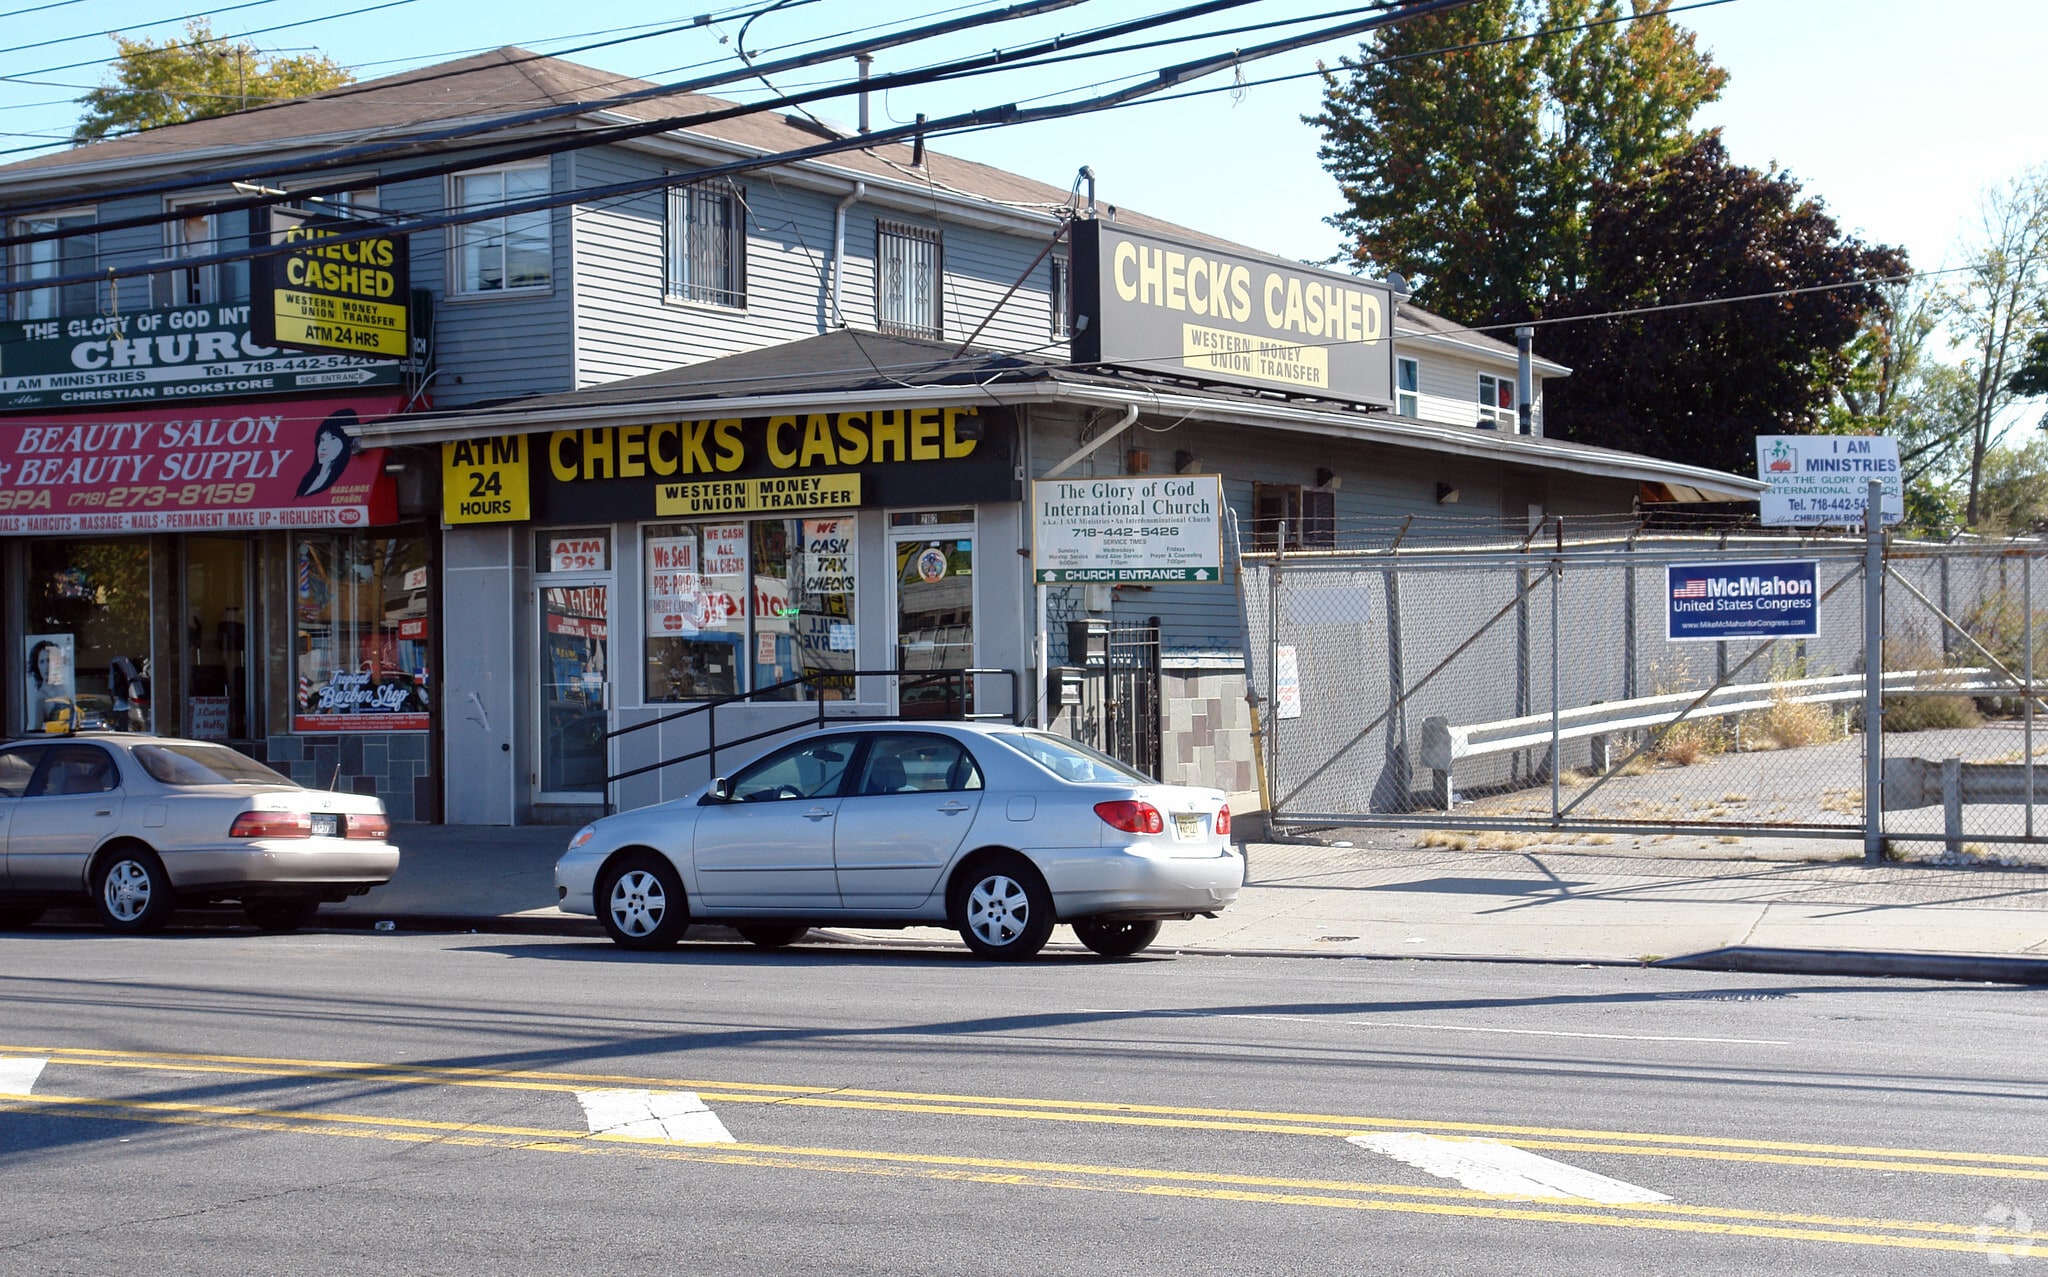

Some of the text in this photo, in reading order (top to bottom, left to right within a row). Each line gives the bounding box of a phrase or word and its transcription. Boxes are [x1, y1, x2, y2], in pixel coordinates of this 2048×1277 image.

[287, 225, 394, 267] CHECKS
[287, 257, 395, 298] CASHED
[1114, 241, 1381, 346] CHECKS CASHED
[285, 293, 378, 315] WESTERN MONEY
[22, 322, 59, 341] THE
[67, 315, 130, 338] GLORY
[136, 313, 162, 332] OF
[169, 310, 210, 330] GOD
[301, 306, 395, 326] UNION TRANSFER
[305, 325, 380, 347] ATM 24 HRS
[1190, 328, 1301, 360] WESTERN MONEY
[71, 330, 304, 370] CHURC
[202, 356, 377, 377] Tel. 718-442-5426
[1210, 350, 1321, 384] UNION TRANSFER
[2, 370, 146, 391] I AM MINISTRIES
[300, 371, 365, 384] SIDE ENTRANCE
[61, 388, 155, 402] CHRISTIAN
[163, 379, 274, 396] BOOKSTORE
[15, 415, 283, 454] BEAUTY SALON
[549, 407, 979, 482] CHECKS CASHED
[451, 434, 520, 468] ATM
[1833, 440, 1871, 454] I AM
[14, 454, 155, 486] BEAUTY
[158, 450, 293, 481] SUPPLY
[1806, 459, 1897, 473] MINISTRIES
[331, 485, 370, 494] HABLAMOS
[468, 472, 503, 497] 24
[665, 477, 822, 499] WESTERN MONEY
[1765, 477, 1790, 485] AKA
[1795, 476, 1816, 484] THE
[1821, 476, 1856, 485] GLORY
[1859, 476, 1871, 484] OF
[1765, 486, 1898, 495] INTERNATIONAL CHCH
[0, 490, 51, 510] SPA
[690, 491, 851, 511] UNION TRANSFER
[1057, 481, 1195, 501] The Glory of God
[460, 500, 511, 516] HOURS
[1044, 498, 1210, 517] International Church
[1788, 497, 1871, 511] Tel. 718-442-54
[27, 517, 72, 531] HAIRCUTS
[79, 515, 123, 530] MASSAGE
[131, 514, 158, 528] NAILS
[166, 513, 224, 528] PERMANENT
[228, 512, 254, 526] MAKE
[259, 511, 271, 525] UP
[279, 508, 336, 525] HIGHLIGHTS
[816, 522, 838, 534] WE
[1188, 515, 1211, 523] Church
[706, 528, 744, 540] WE CASH
[1072, 526, 1180, 538] 718-442-5426
[555, 540, 601, 554] ATM
[717, 544, 734, 555] ALL
[810, 538, 850, 554] CASH
[1174, 551, 1203, 559] Counseling
[560, 556, 596, 569] 99¢
[653, 545, 691, 568] We Sell
[706, 557, 744, 573] TAX CHECKS
[817, 557, 848, 573] TAX
[806, 576, 855, 591] CHECKS
[1065, 569, 1186, 580] CHURCH ENTRANCE
[1707, 577, 1812, 597] McMahon
[1673, 597, 1812, 612] United States Congress
[1682, 619, 1806, 629] www.MikeMcMahonforCongress.com
[330, 669, 371, 691] Tropical
[319, 683, 410, 712] Barber Shop
